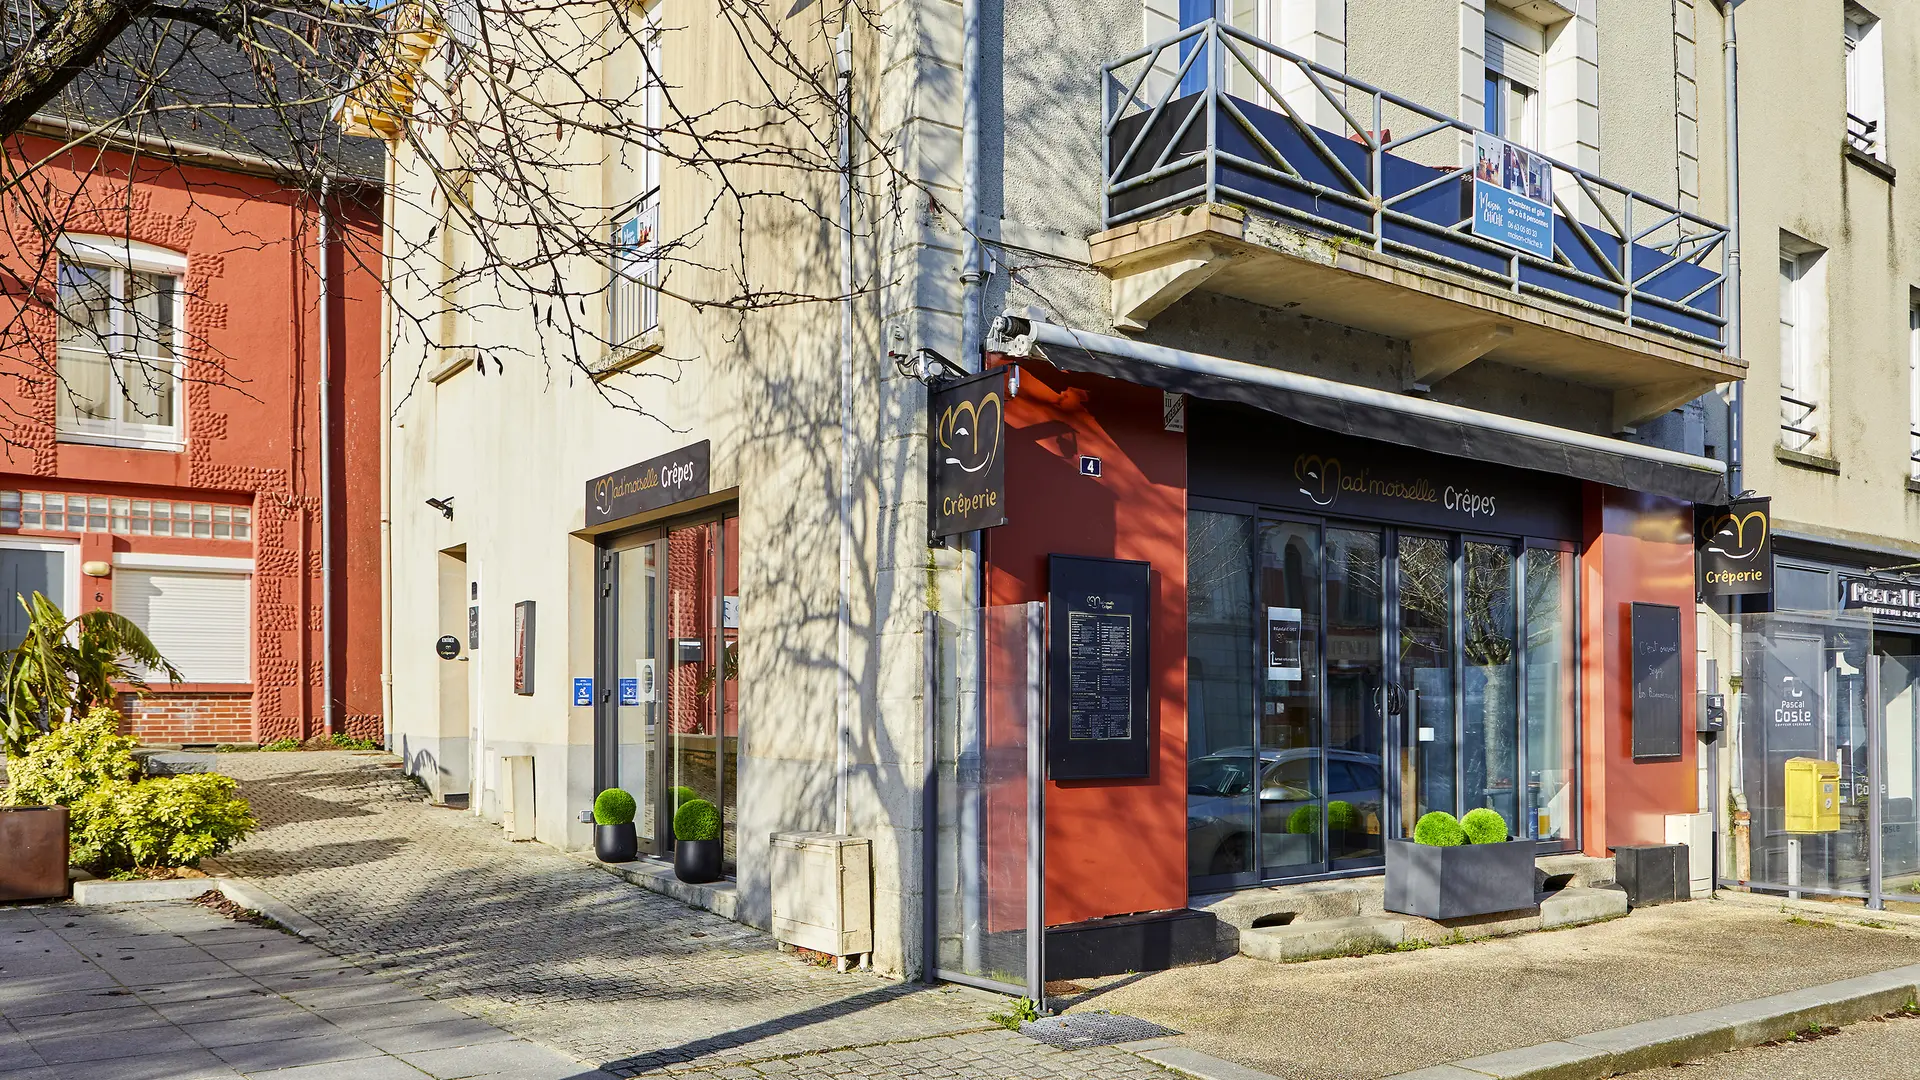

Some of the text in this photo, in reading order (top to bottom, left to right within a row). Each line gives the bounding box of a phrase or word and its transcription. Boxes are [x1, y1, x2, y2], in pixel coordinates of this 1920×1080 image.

[1507, 197, 1531, 212] Chambres
[1507, 207, 1514, 215] de
[1527, 215, 1549, 228] personnes
[661, 461, 694, 490] Crêpes
[1087, 460, 1094, 473] 4
[943, 488, 997, 519] Crêperie
[1444, 485, 1496, 518] Crêpes
[1706, 568, 1762, 587] Crêperie
[1851, 583, 1908, 607] Pascal
[1782, 700, 1804, 709] Pascal
[1775, 709, 1811, 722] Coste
